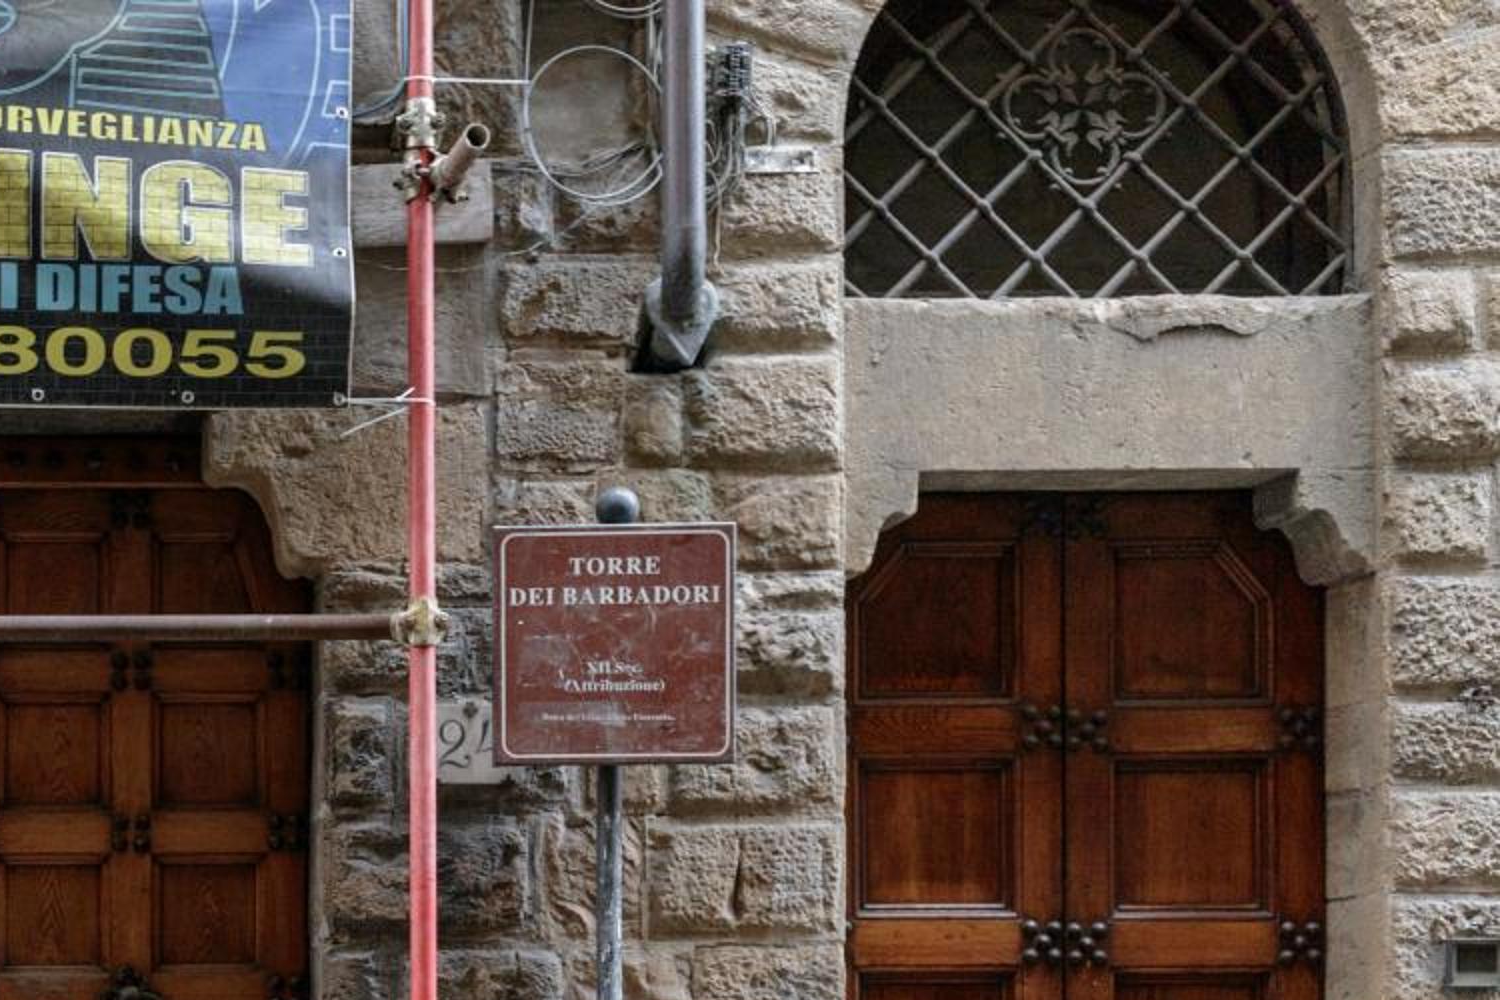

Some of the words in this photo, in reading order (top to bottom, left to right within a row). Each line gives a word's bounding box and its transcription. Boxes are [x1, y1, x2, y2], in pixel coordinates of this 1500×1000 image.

[35, 262, 244, 315] DIFESA
[568, 555, 661, 577] TORRE
[509, 587, 555, 607] DEI
[562, 584, 722, 606] BARBADORI
